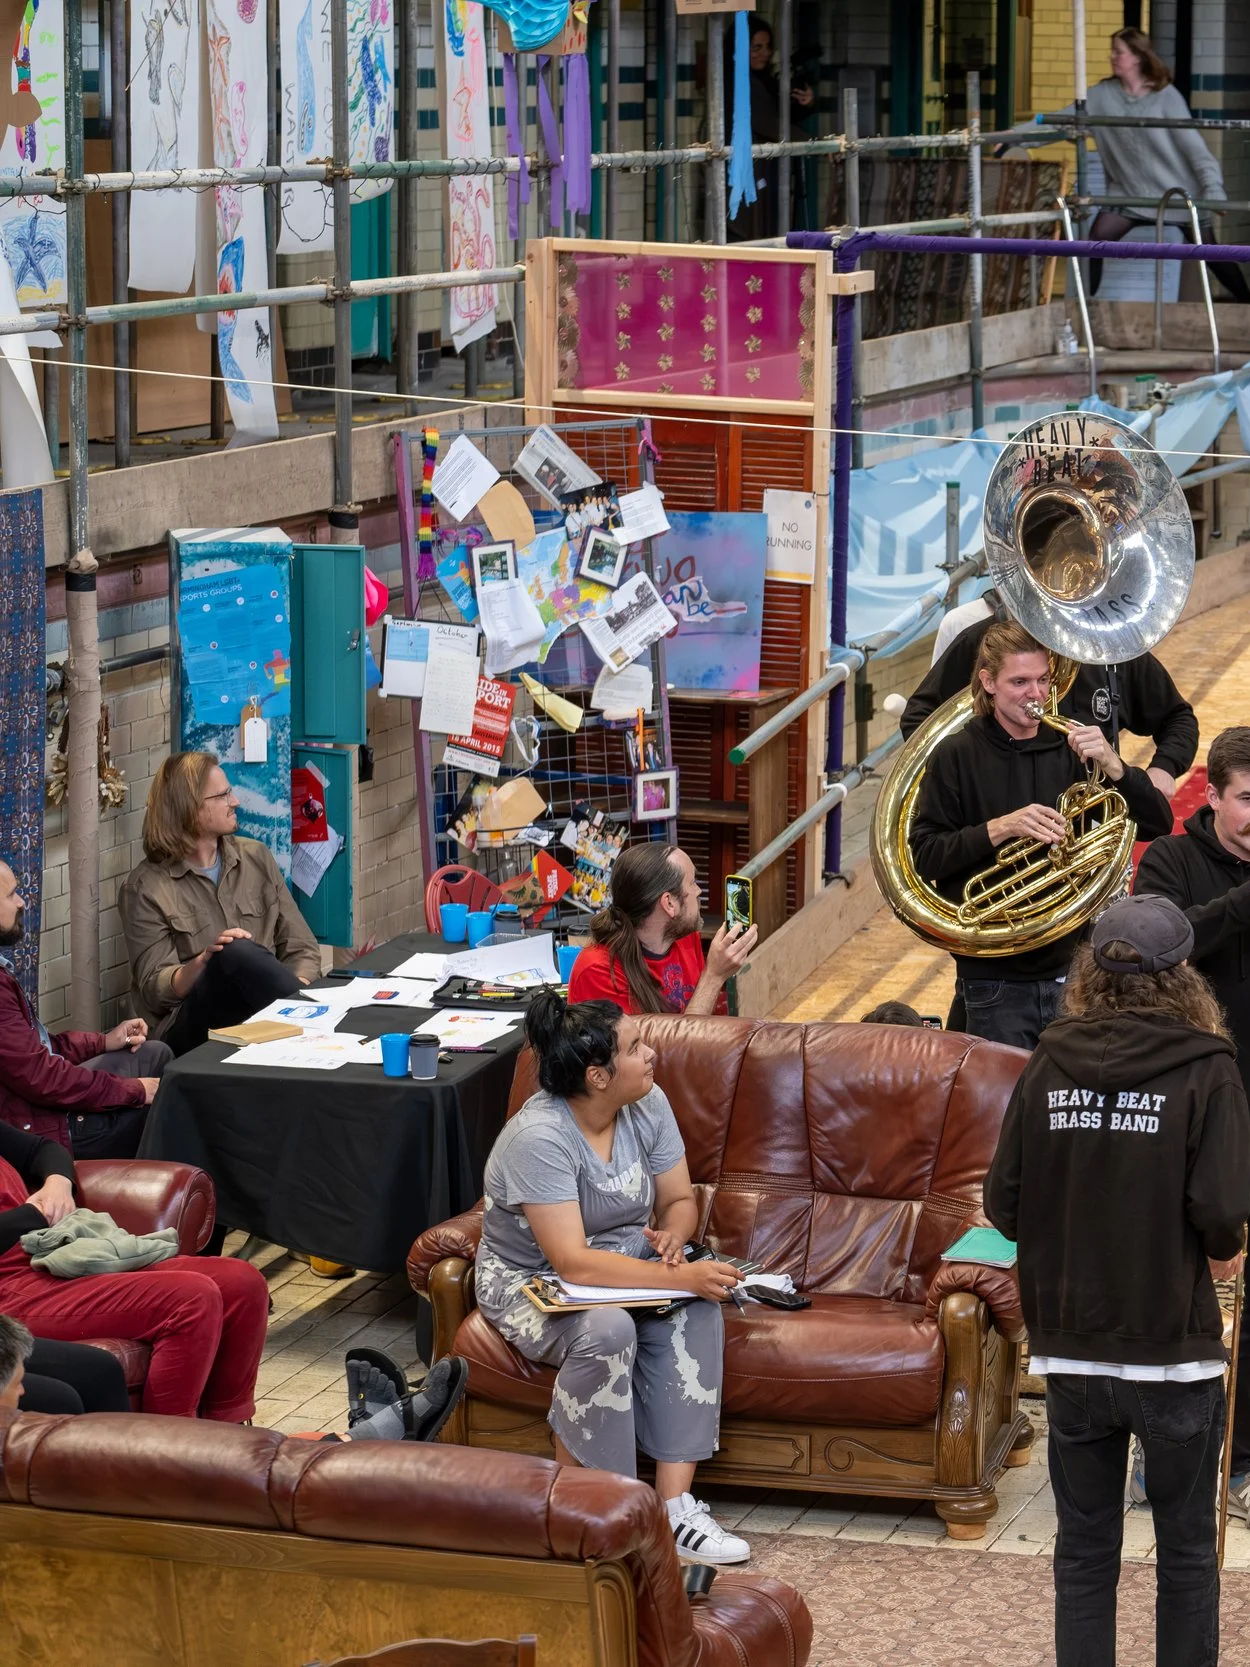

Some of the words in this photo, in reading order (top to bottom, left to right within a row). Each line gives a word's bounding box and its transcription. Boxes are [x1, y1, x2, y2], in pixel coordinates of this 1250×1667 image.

[1024, 417, 1087, 460] HEAVY
[1033, 448, 1085, 488] BEAT
[781, 521, 799, 533] NO
[209, 584, 243, 596] GROUPS
[687, 601, 717, 617] be
[436, 626, 469, 639] October
[478, 679, 500, 695] IDE
[476, 689, 511, 709] PORT
[460, 736, 482, 749] APRIL
[1047, 1088, 1107, 1109] HEAVY
[1115, 1091, 1167, 1112] BEAT
[1049, 1111, 1103, 1131] BRASS
[1109, 1112, 1160, 1134] BAND
